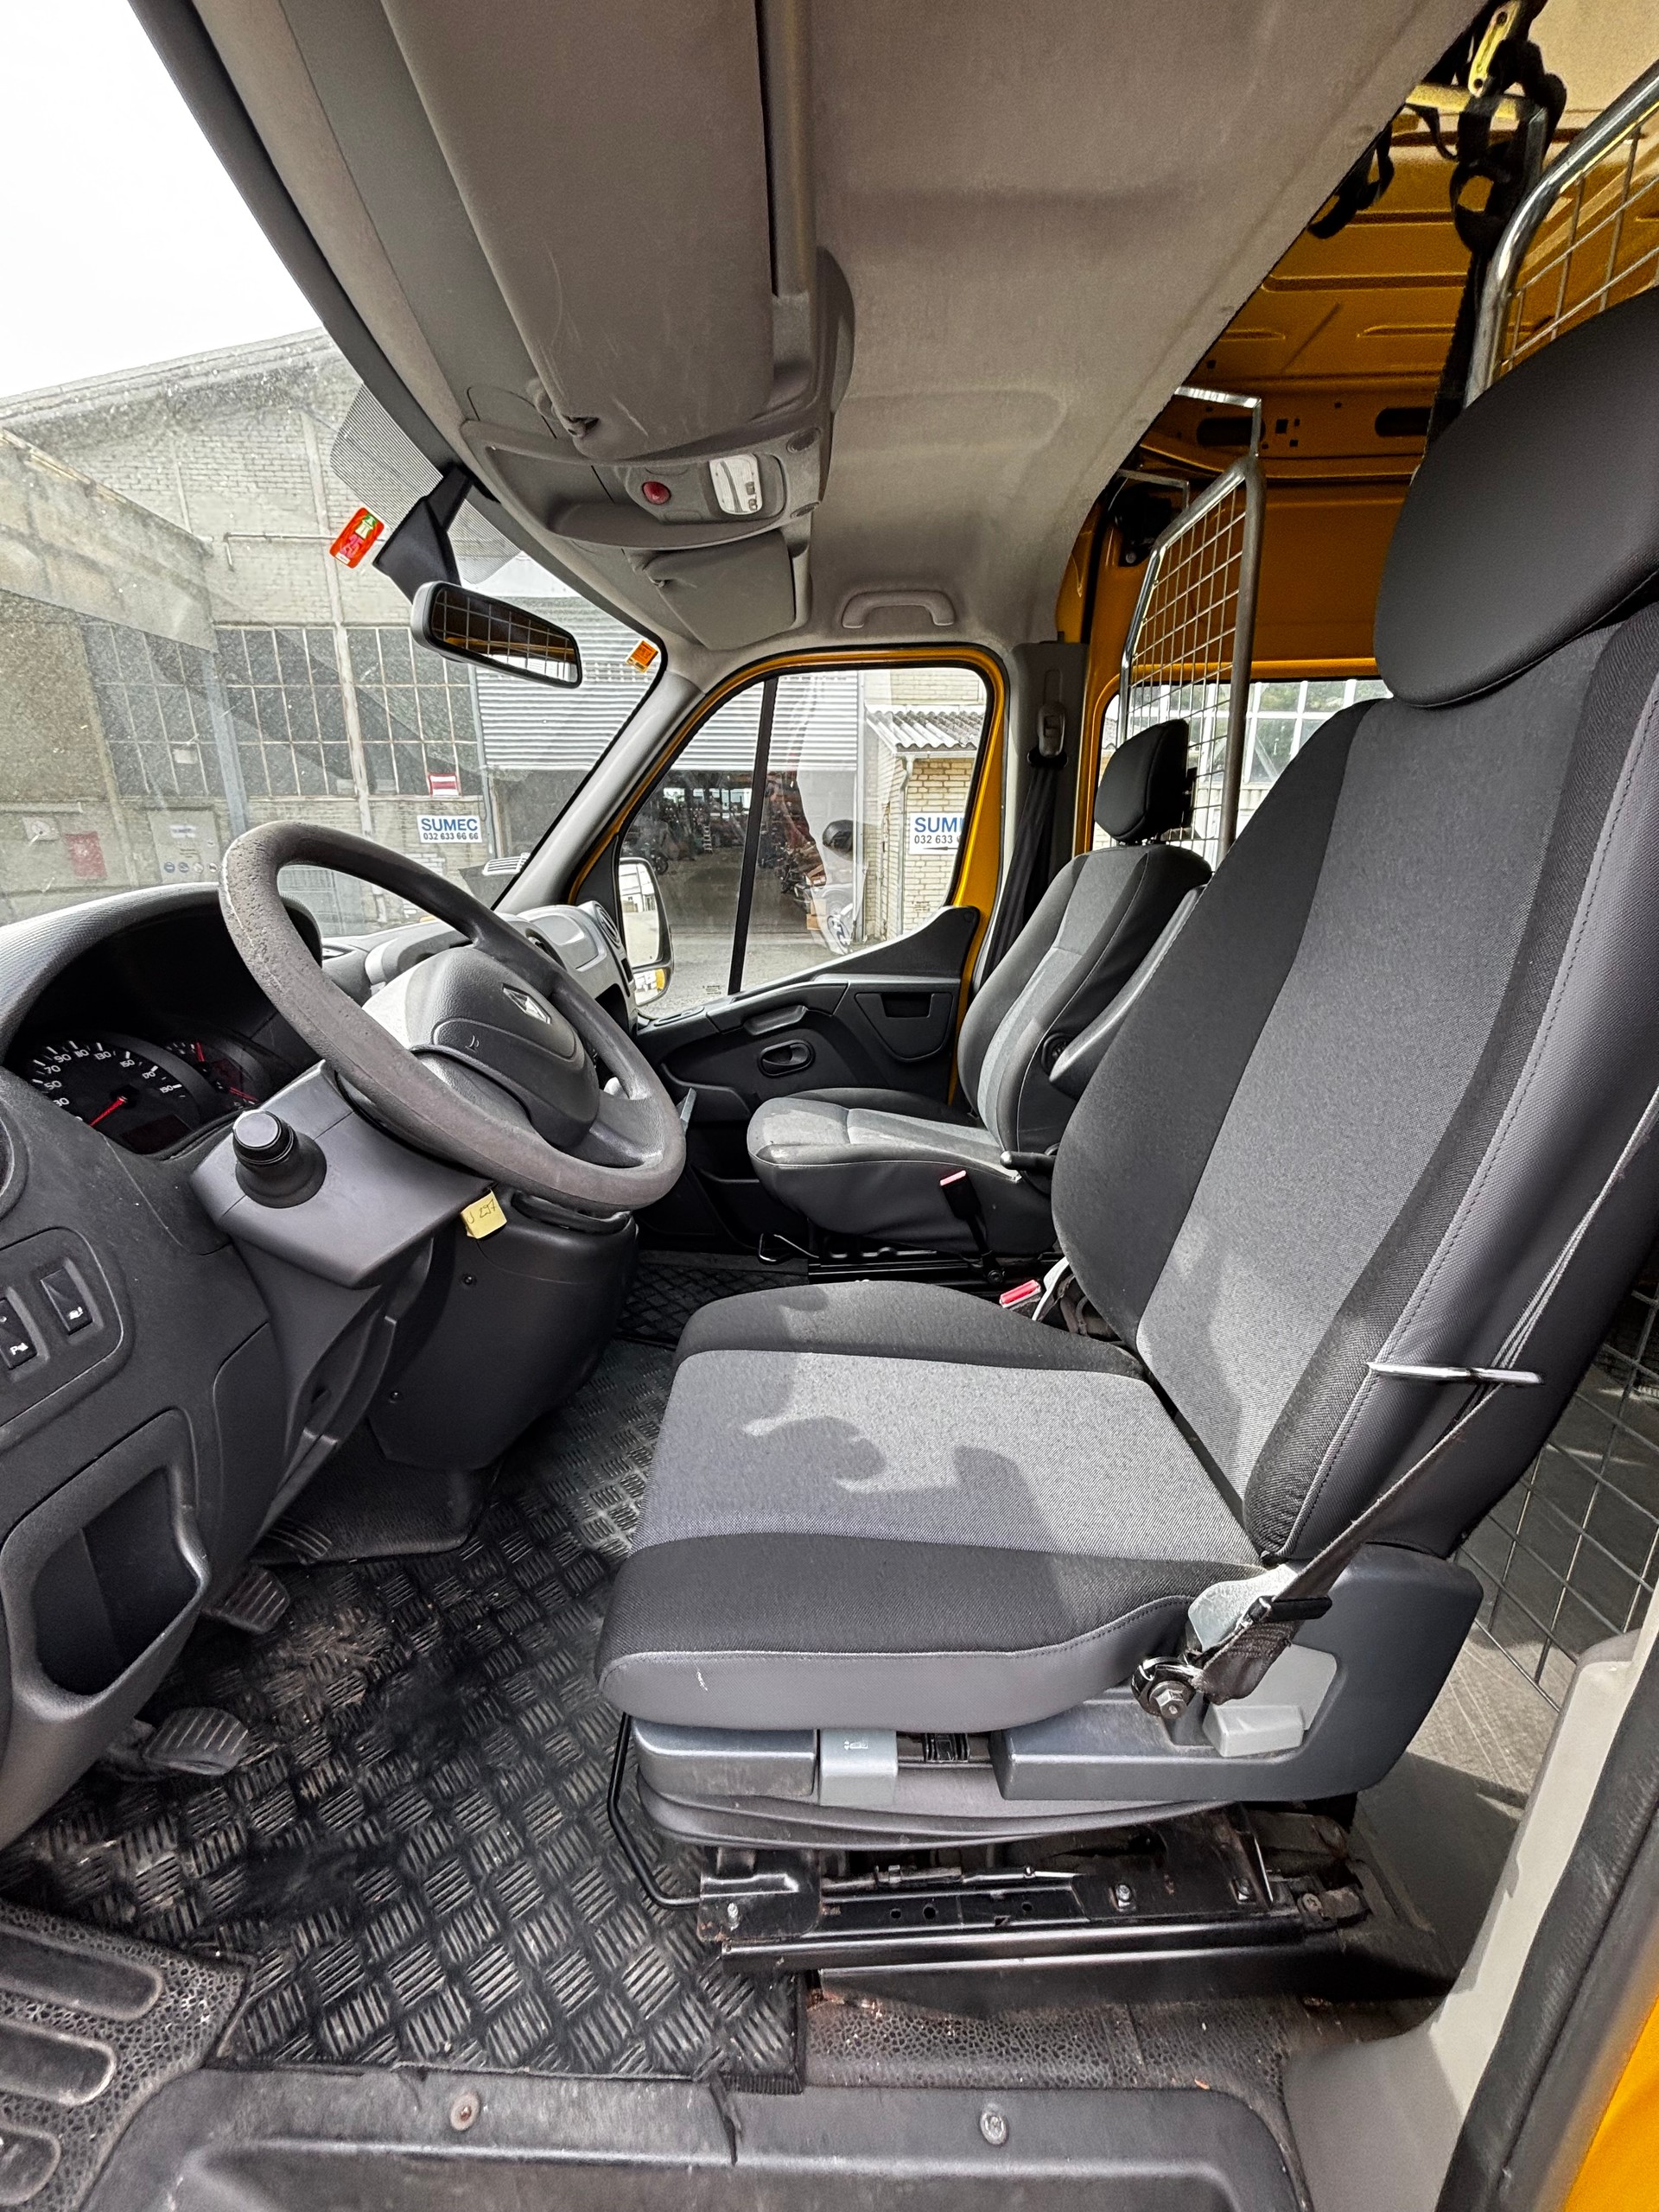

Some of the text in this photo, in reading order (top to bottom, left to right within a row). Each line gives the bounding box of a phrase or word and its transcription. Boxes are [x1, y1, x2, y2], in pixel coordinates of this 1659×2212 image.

[421, 818, 478, 831] SUMEC
[914, 835, 932, 844] 032
[935, 835, 953, 844] 633
[54, 1053, 72, 1064] 90
[94, 1051, 111, 1060] 130
[43, 1065, 61, 1074] 70
[43, 1080, 62, 1090] 50
[53, 1097, 70, 1107] 30
